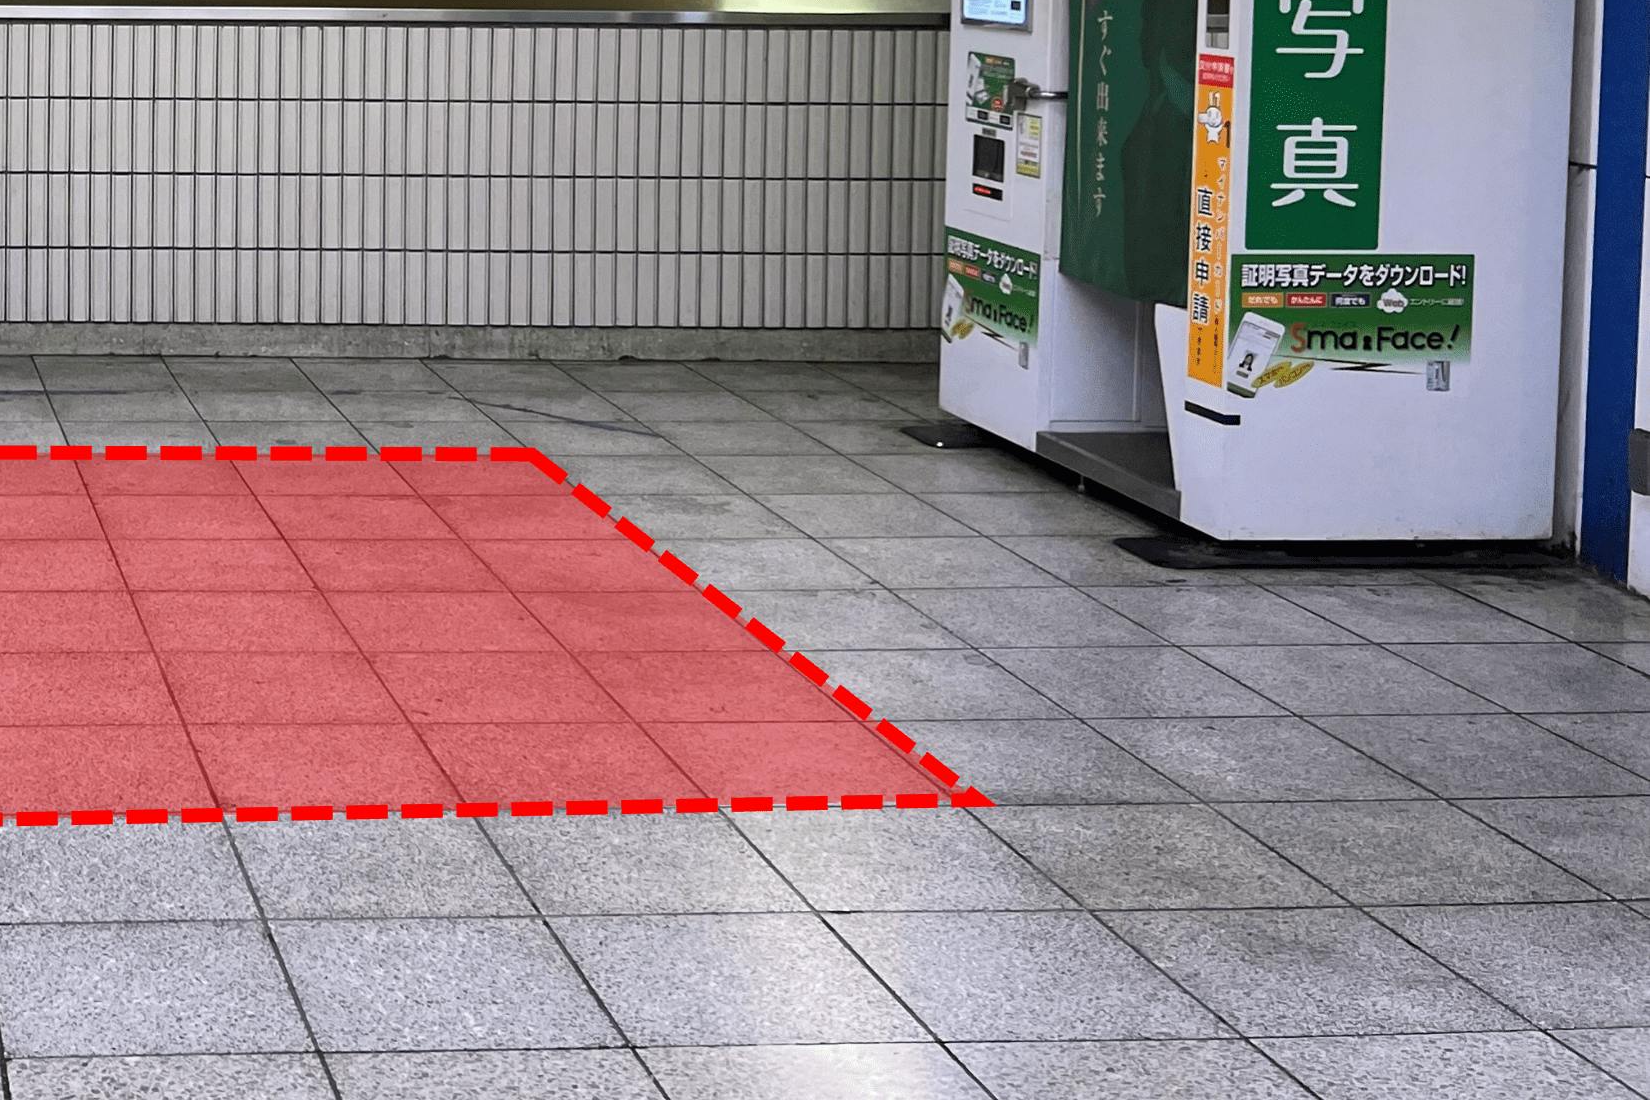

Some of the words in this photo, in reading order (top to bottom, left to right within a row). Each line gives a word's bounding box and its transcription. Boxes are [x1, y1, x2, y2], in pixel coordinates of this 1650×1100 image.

[1093, 10, 1114, 218] すぐ出来ます
[1241, 264, 1467, 288] 証明写真データをダウンロード!
